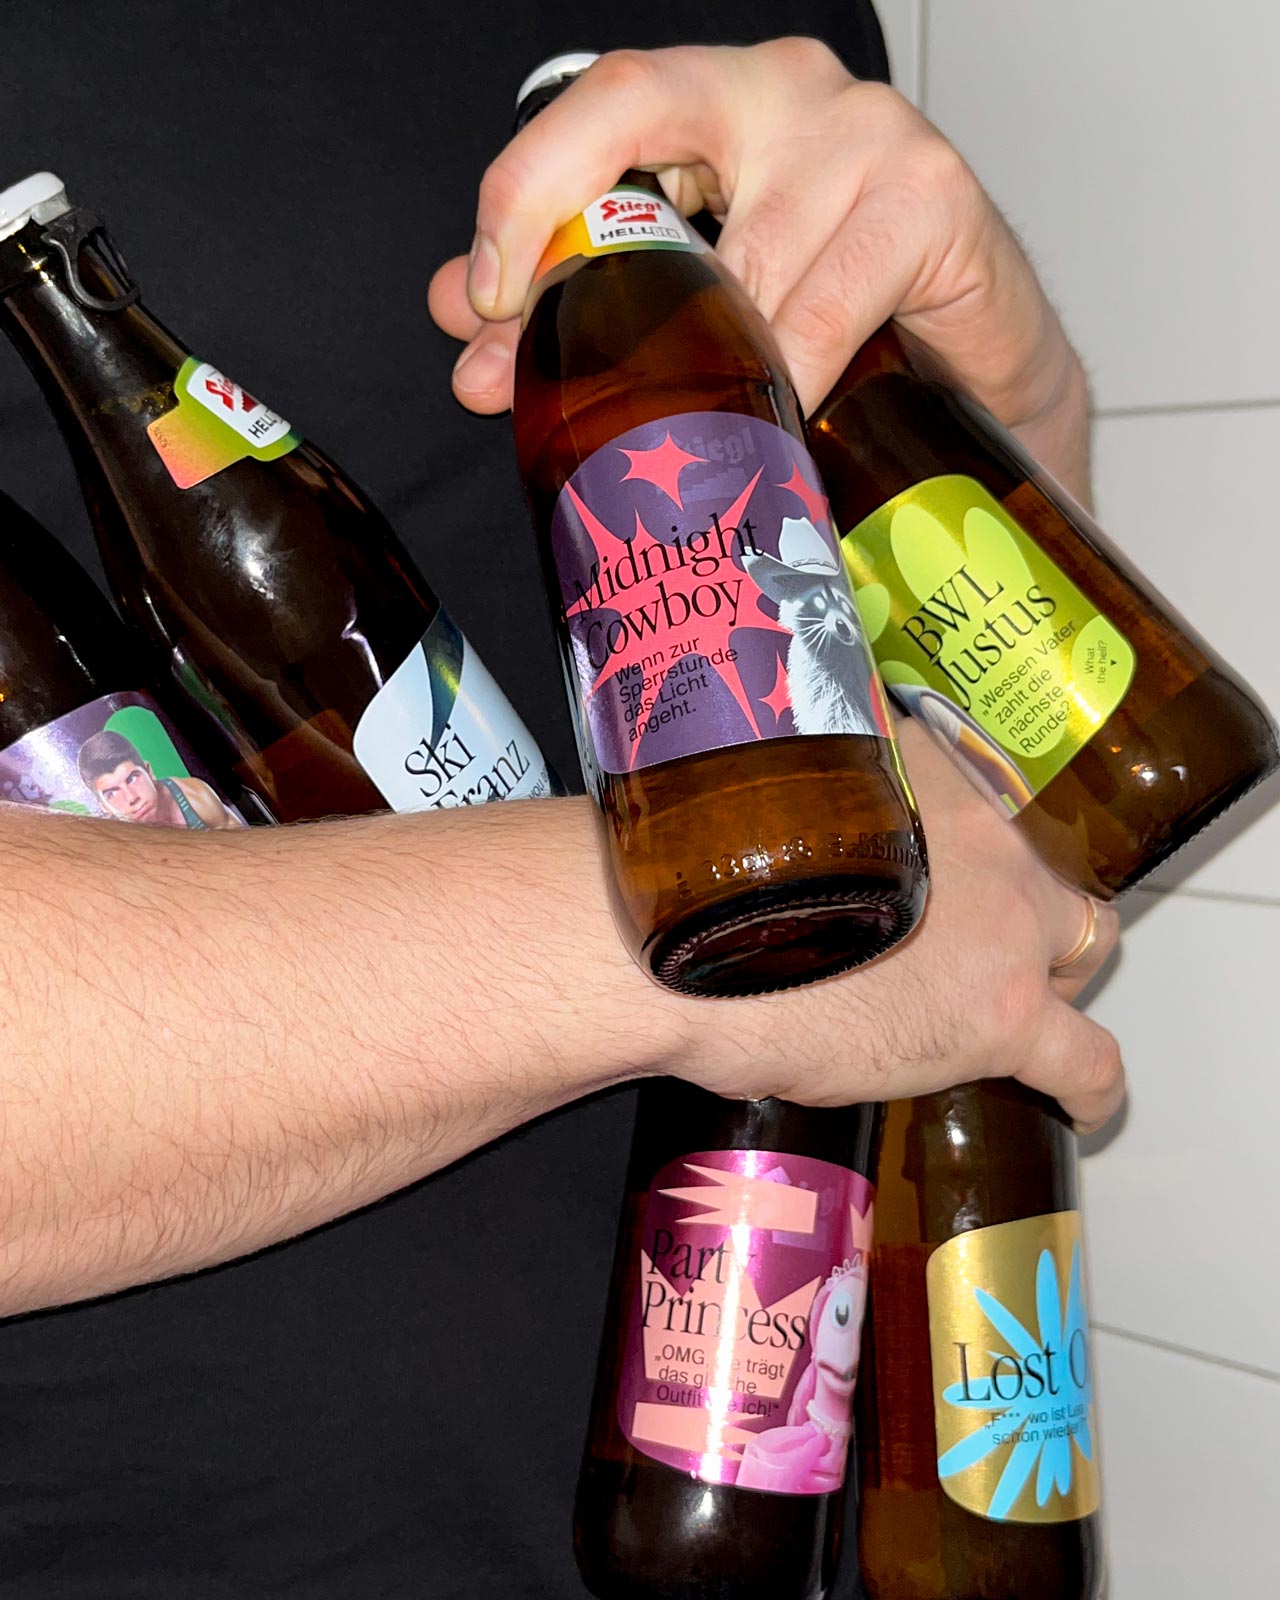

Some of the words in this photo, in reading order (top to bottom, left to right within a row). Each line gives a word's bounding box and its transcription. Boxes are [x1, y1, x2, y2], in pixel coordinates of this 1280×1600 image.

[600, 199, 662, 221] Stiegl
[573, 512, 765, 624] Midnight
[586, 578, 744, 670] Cowboy
[901, 564, 1005, 663] BWL
[614, 650, 665, 685] Wenn
[669, 637, 701, 660] zur
[931, 585, 1056, 712] Justus
[1035, 620, 1077, 657] Vater
[1085, 647, 1095, 674] What
[619, 648, 739, 704] Sperrstunde
[624, 699, 655, 723] das
[659, 674, 710, 703] Licht
[994, 685, 1030, 725] zahlt
[1027, 668, 1053, 699] die
[1097, 666, 1106, 684] the
[628, 700, 698, 743] angeht.
[1008, 684, 1064, 740] nächste
[404, 722, 477, 798] Ski
[647, 1228, 757, 1285] Part
[658, 1364, 689, 1384] das
[693, 1371, 757, 1394] glhe
[746, 1357, 785, 1381] trägt
[952, 1340, 1060, 1402] Lost
[656, 1384, 704, 1408] Outfit
[1029, 1410, 1049, 1424] wo
[1051, 1406, 1066, 1422] ist
[992, 1430, 1040, 1446] schon
